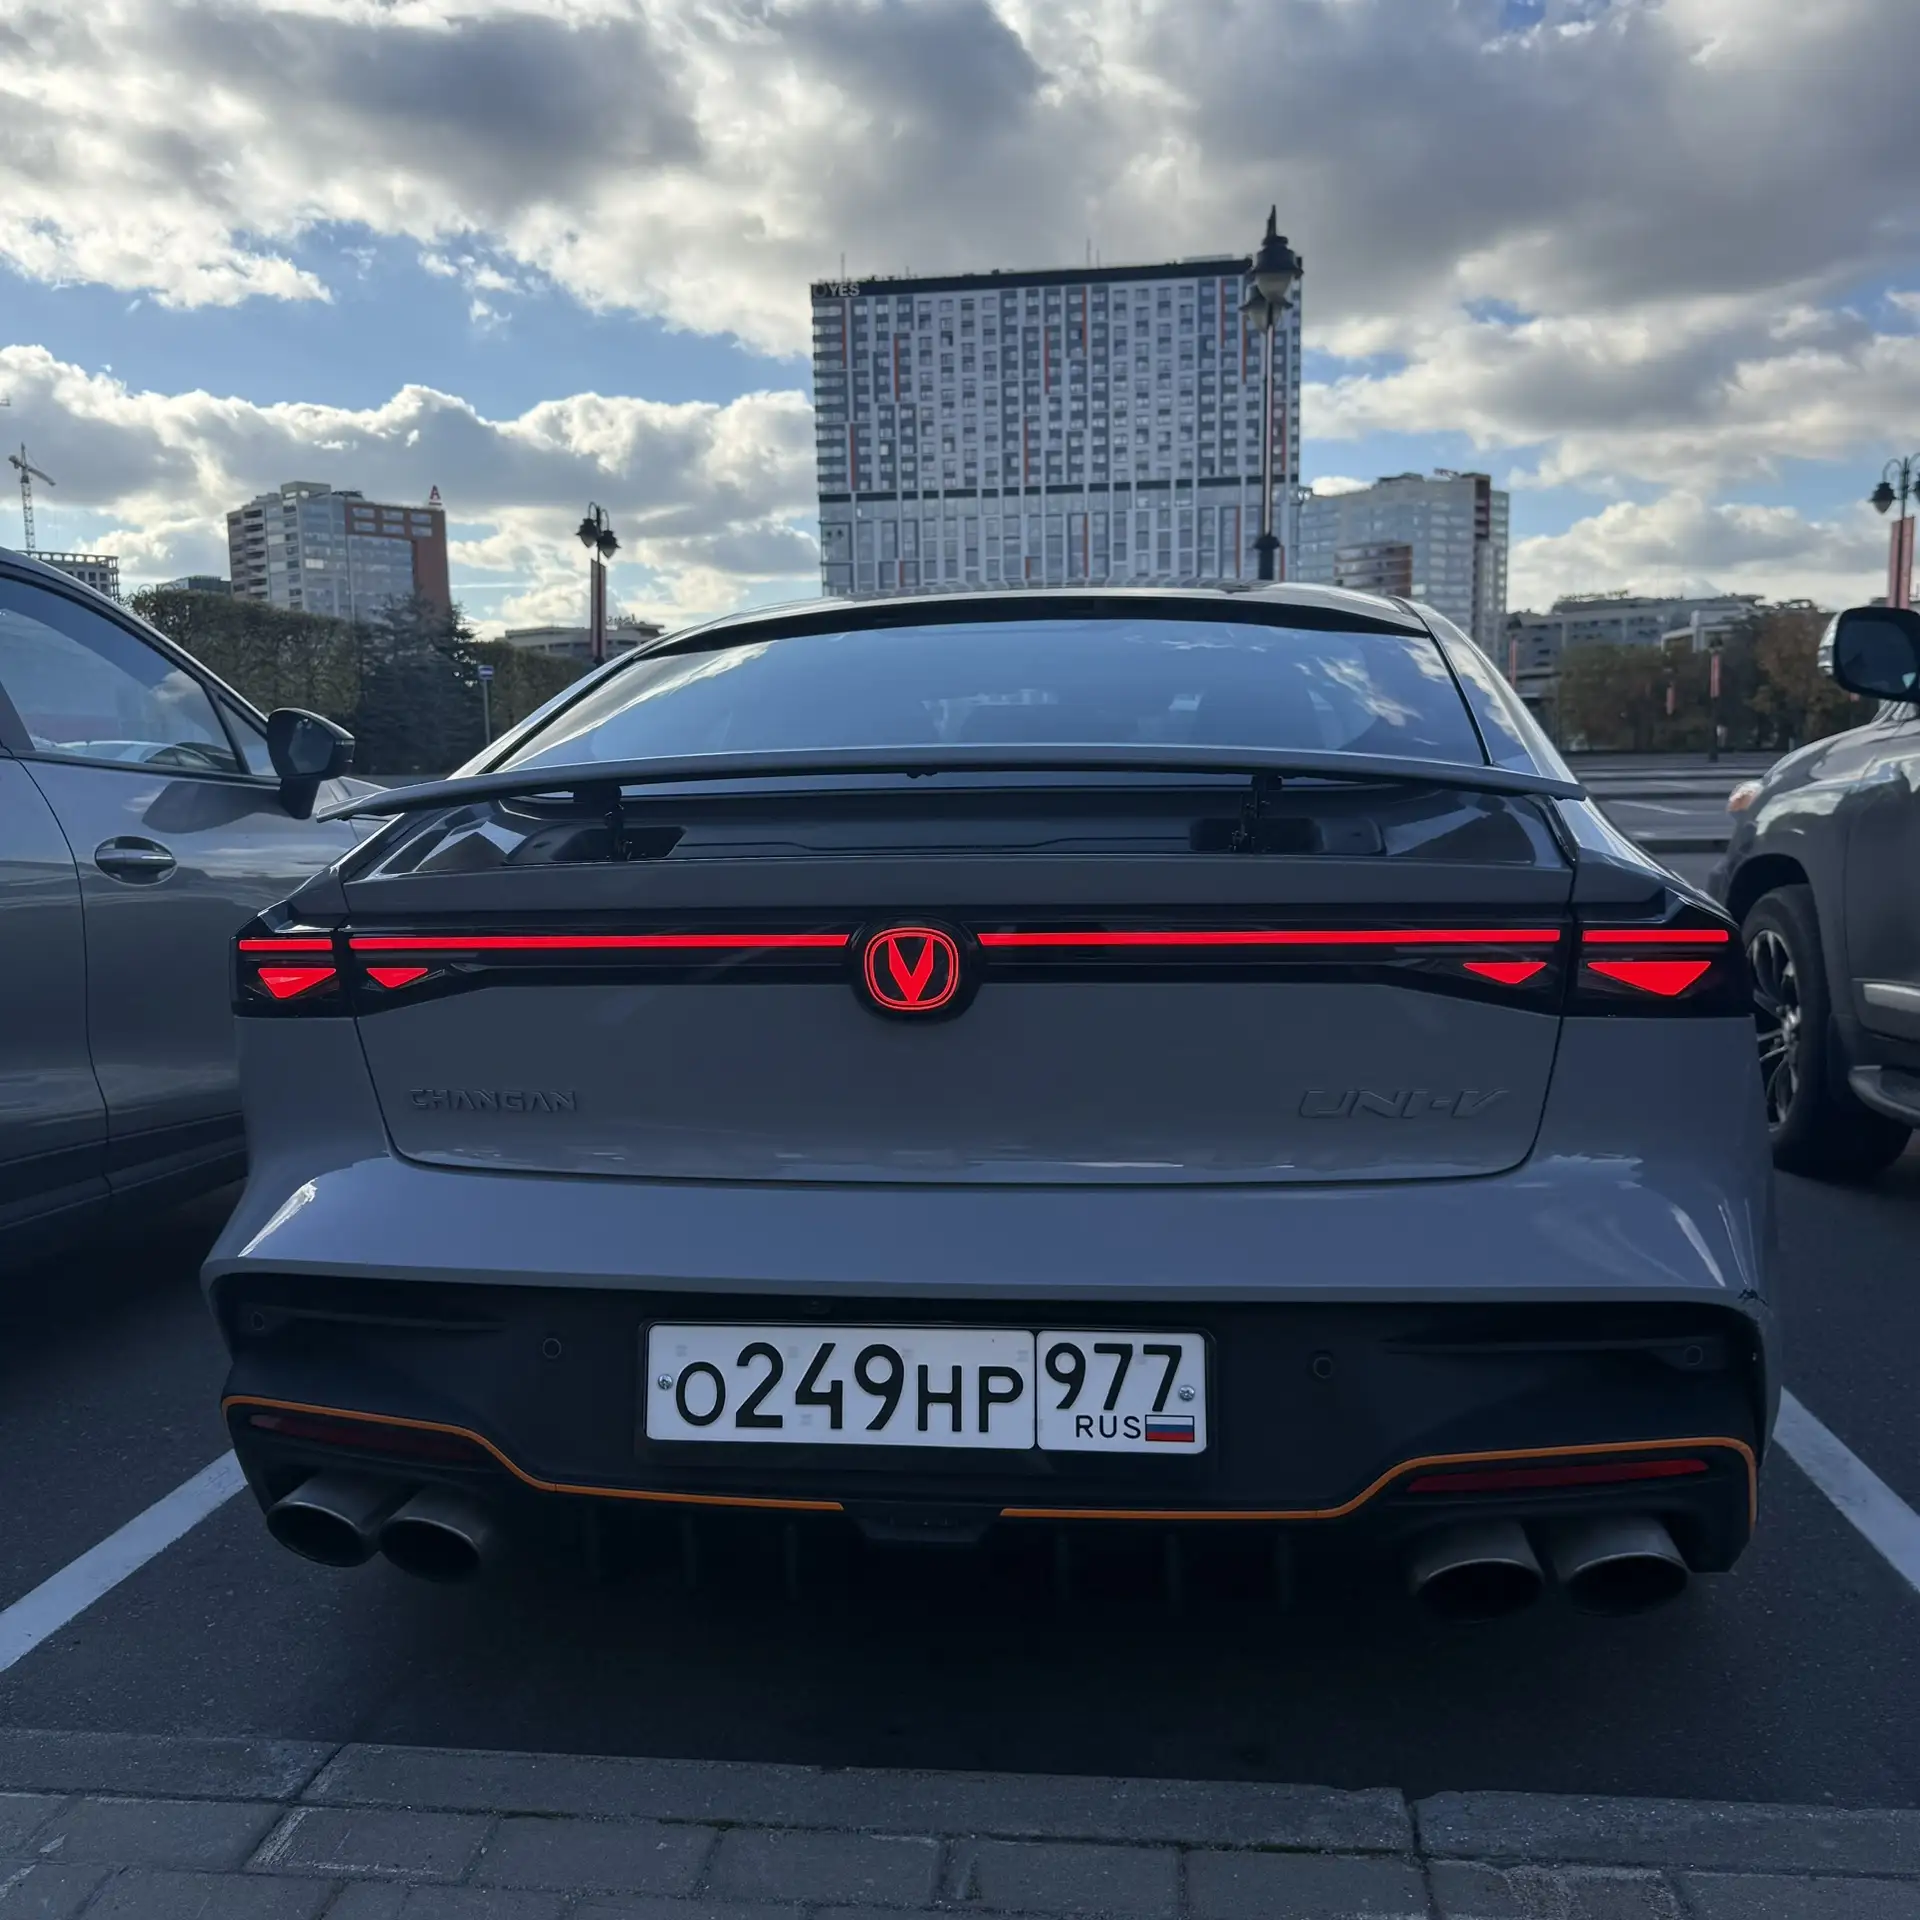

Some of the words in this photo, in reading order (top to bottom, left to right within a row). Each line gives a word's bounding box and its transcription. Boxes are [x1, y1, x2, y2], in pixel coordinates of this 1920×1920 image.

[409, 1089, 577, 1112] CHANGAN
[1299, 1089, 1509, 1118] UNI-V
[1044, 1342, 1183, 1412] 977
[1075, 1414, 1142, 1439] RUS
